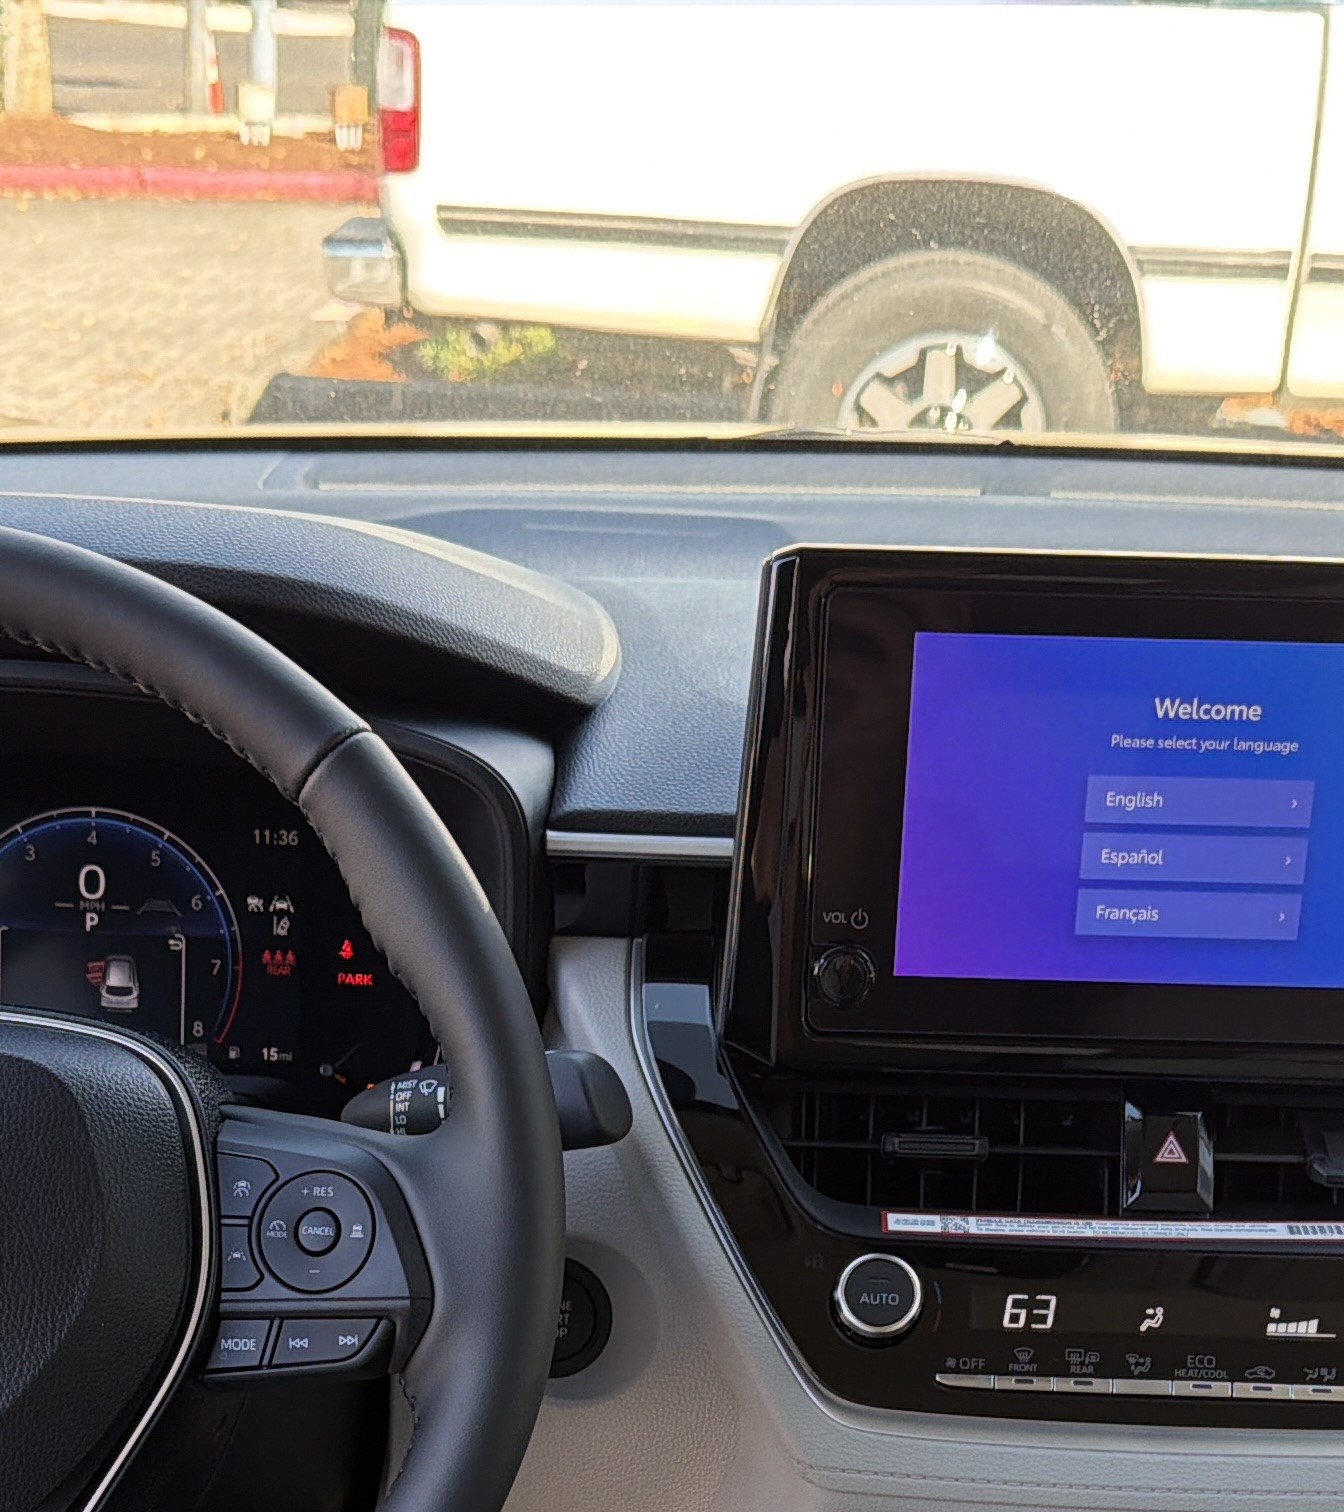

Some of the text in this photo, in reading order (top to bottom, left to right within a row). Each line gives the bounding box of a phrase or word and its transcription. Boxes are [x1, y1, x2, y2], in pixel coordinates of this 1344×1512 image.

[1154, 697, 1262, 721] Welcome
[1110, 733, 1299, 756] Please select your language
[1106, 791, 1163, 811] English
[87, 829, 98, 846] 4
[253, 829, 299, 846] 11:36
[25, 846, 36, 862] 3
[151, 850, 161, 867] 5
[1100, 848, 1163, 867] Español
[78, 864, 106, 900] 0
[191, 894, 203, 911] 6
[85, 912, 99, 932] P
[823, 911, 846, 924] VOL
[1095, 904, 1159, 924] Français
[210, 960, 222, 976] 7
[337, 973, 374, 986] PARK
[192, 1020, 204, 1038] 8
[396, 1090, 413, 1102] OFF
[267, 1230, 288, 1239] MODE
[301, 1225, 335, 1237] CANCEL
[859, 1292, 900, 1306] AUTO
[1003, 1294, 1057, 1329] 63
[221, 1339, 257, 1351] MODE
[959, 1357, 986, 1370] OFF
[1008, 1363, 1038, 1373] FRONT
[1070, 1364, 1094, 1374] REAR
[1187, 1355, 1216, 1368] ECO
[1174, 1368, 1230, 1379] HEAT/COOL
